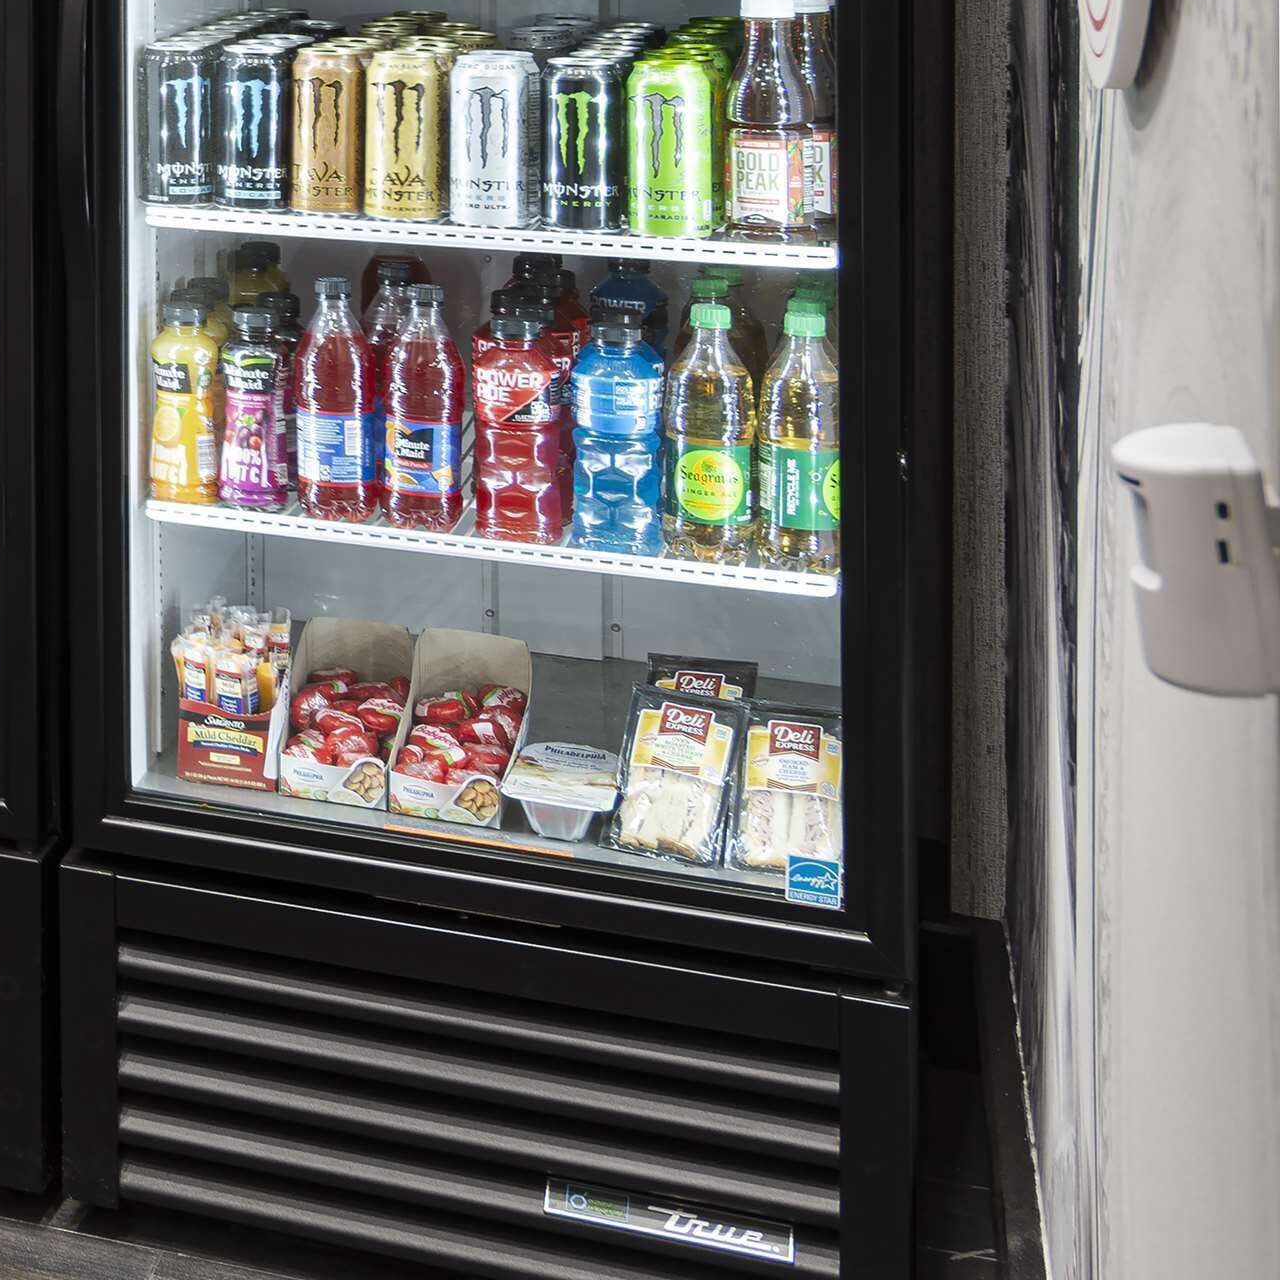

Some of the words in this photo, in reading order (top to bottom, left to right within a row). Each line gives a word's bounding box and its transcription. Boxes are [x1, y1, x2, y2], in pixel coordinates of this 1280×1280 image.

[736, 151, 781, 172] GOLD
[736, 171, 780, 192] PEAK
[543, 182, 619, 200] MONSTER
[477, 367, 541, 388] POWER
[680, 676, 716, 689] Deli
[666, 709, 706, 727] Deli
[194, 730, 214, 742] Mild
[216, 732, 259, 746] Cheddar
[666, 723, 704, 737] EXPRESS
[774, 726, 814, 745] Deli
[775, 742, 815, 753] EXPRESS
[790, 892, 816, 902] ENERGY
[817, 895, 839, 906] STAR
